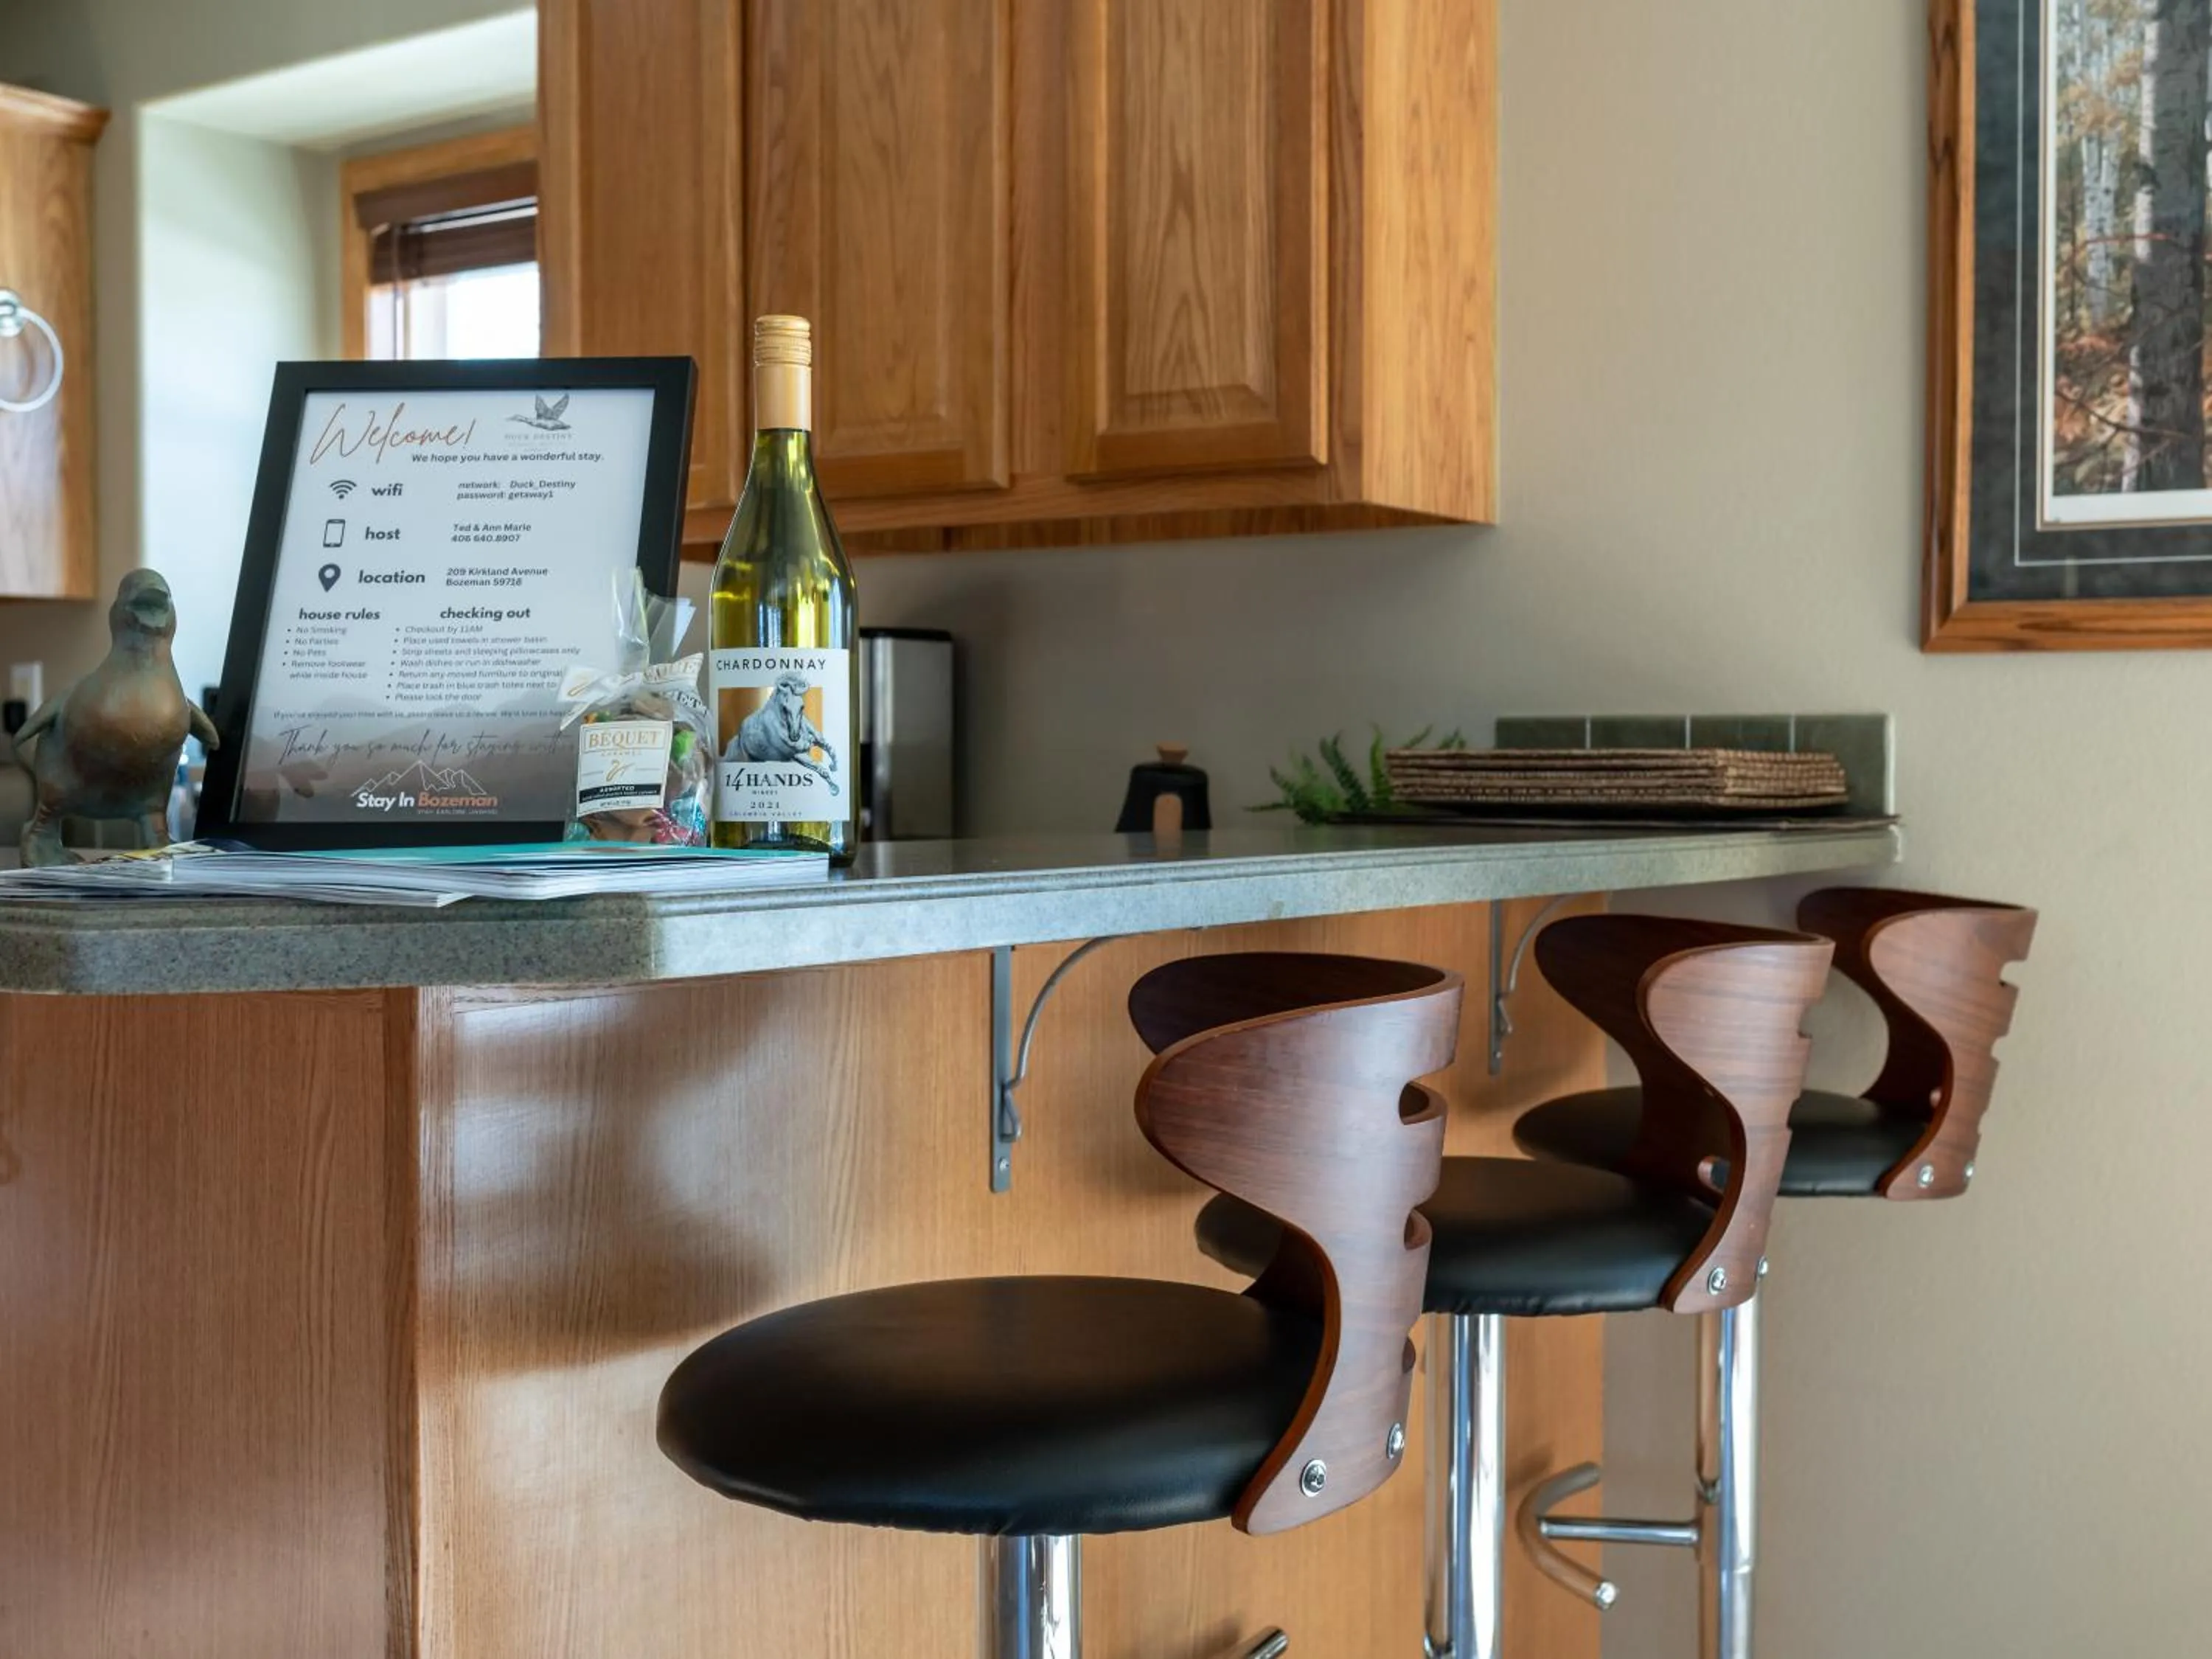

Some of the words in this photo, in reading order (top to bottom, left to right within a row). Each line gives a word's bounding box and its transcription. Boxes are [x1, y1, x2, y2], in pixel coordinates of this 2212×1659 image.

[310, 402, 476, 465] Welcome!
[411, 453, 428, 462] We
[431, 453, 458, 463] hope
[459, 454, 480, 464] you
[483, 453, 509, 462] have
[520, 452, 576, 462] wonderful
[577, 452, 605, 462] stay.
[457, 481, 500, 489] network:
[509, 481, 576, 490] Duck_Destiny
[371, 484, 403, 498] wifi
[456, 491, 505, 500] password:
[507, 491, 553, 500] getaway1
[453, 523, 471, 532] Ted
[482, 523, 502, 532] Ann
[504, 523, 532, 532] Marie
[364, 526, 401, 540] host
[446, 567, 466, 576] 209
[468, 567, 509, 576] Kirkland
[511, 567, 548, 576] Avenue
[358, 569, 426, 584] location
[445, 577, 490, 586] Bozeman
[493, 577, 523, 586] 59718
[299, 607, 341, 620] house
[344, 607, 380, 620] rules
[439, 607, 504, 622] checking
[507, 607, 531, 619] out
[405, 625, 445, 633] Checkout
[403, 636, 427, 644] Place
[561, 646, 582, 655] only
[715, 658, 826, 672] CHARDONNAY
[399, 670, 428, 678] Return
[396, 681, 421, 689] Place
[394, 693, 424, 701] Please
[278, 724, 329, 765] Thank
[331, 742, 360, 768] you
[389, 728, 432, 757] much
[431, 732, 462, 768] for
[356, 791, 397, 812] Stay
[399, 791, 415, 807] In
[418, 792, 498, 807] Bozeman
[749, 801, 780, 809] 2021
